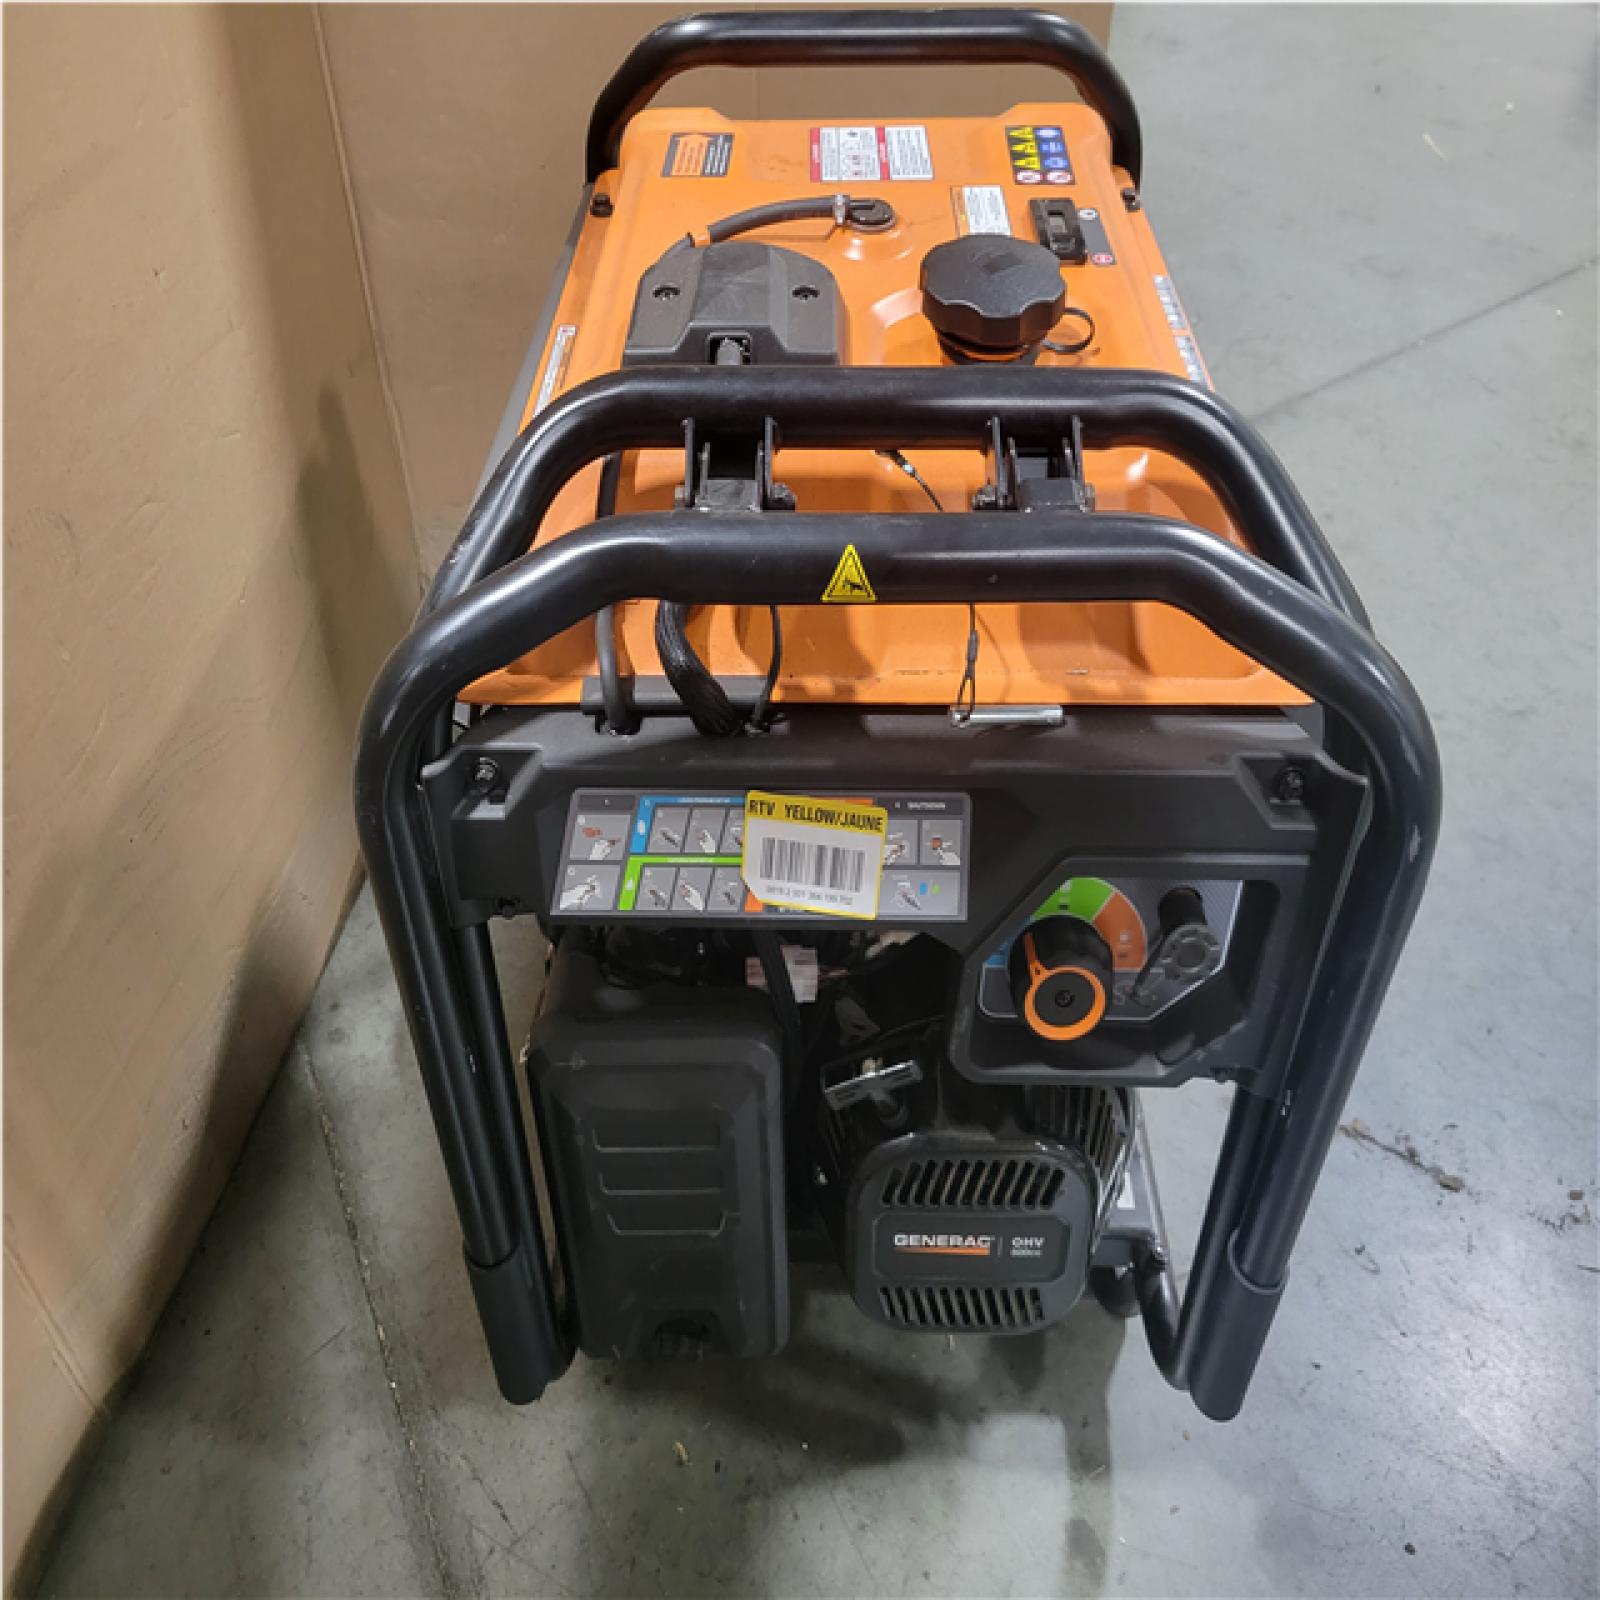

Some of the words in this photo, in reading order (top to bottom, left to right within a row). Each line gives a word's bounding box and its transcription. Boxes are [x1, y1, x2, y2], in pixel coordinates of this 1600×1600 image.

[748, 799, 775, 815] RTV
[784, 804, 883, 833] YELLOW/JAUNE
[894, 1234, 993, 1248] GENERAC
[1011, 1237, 1045, 1248] OHV
